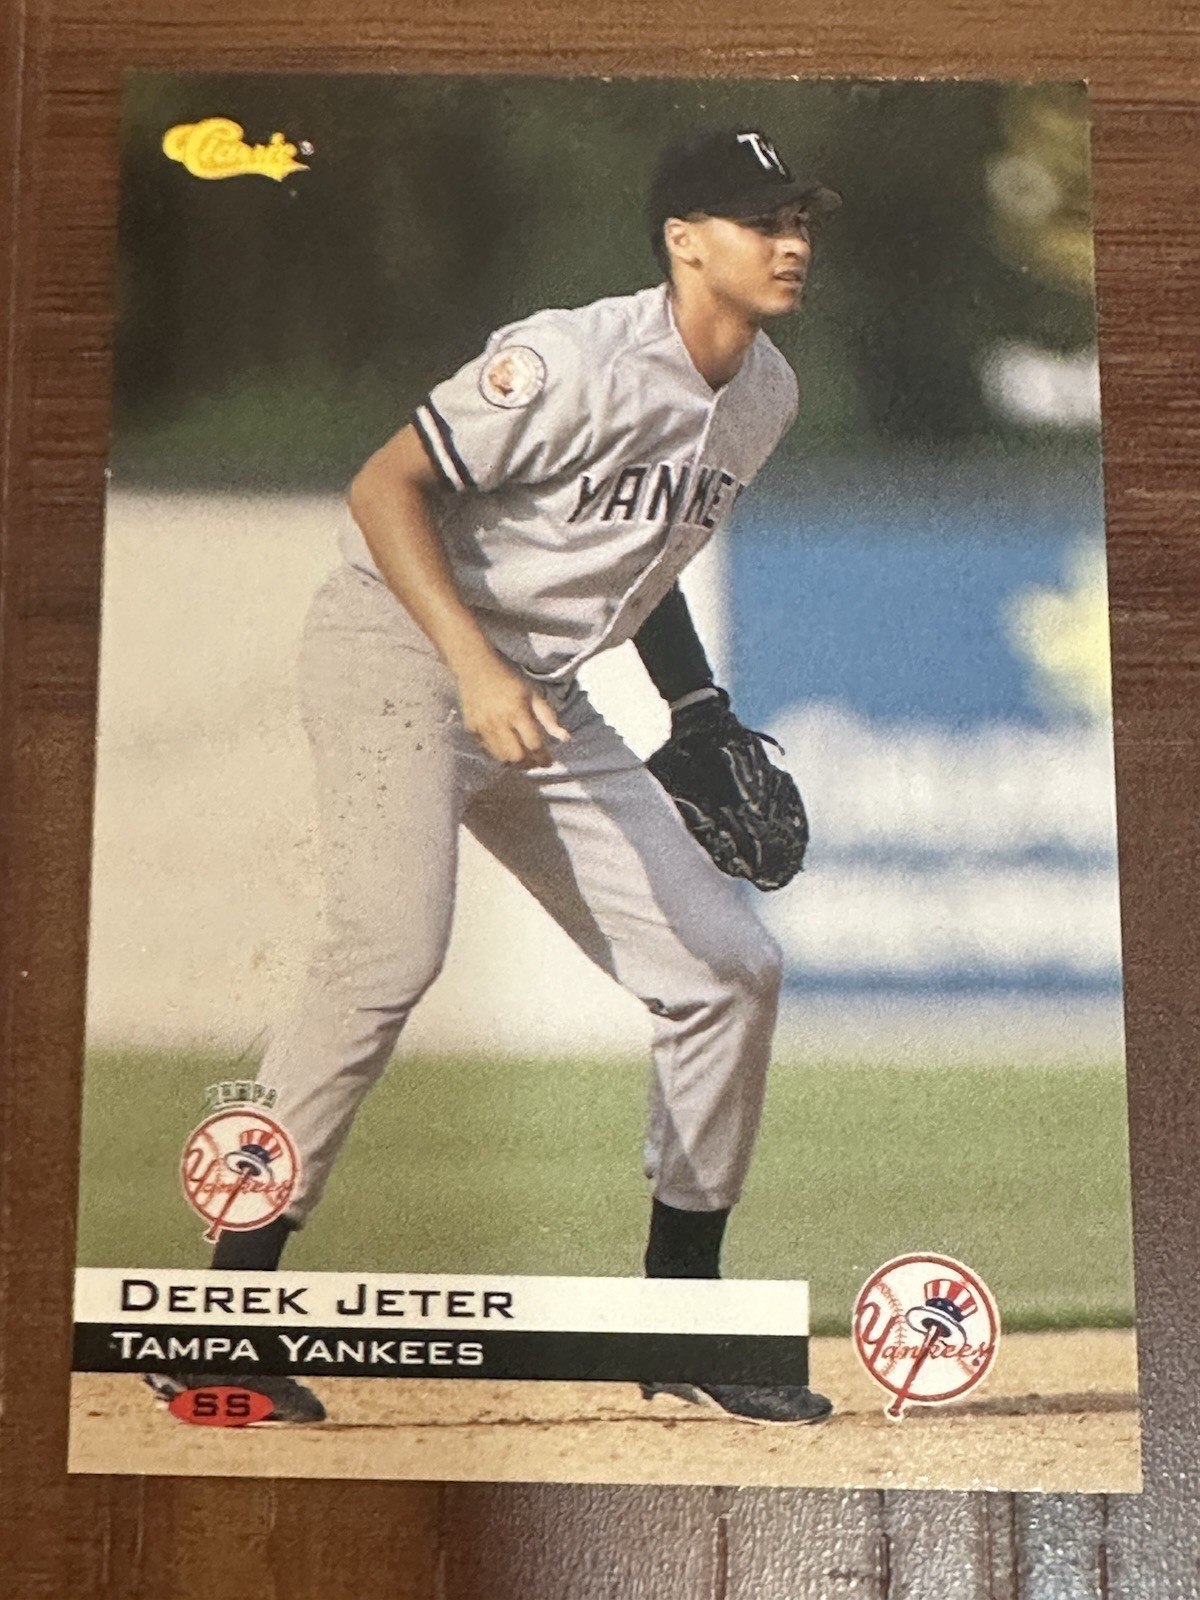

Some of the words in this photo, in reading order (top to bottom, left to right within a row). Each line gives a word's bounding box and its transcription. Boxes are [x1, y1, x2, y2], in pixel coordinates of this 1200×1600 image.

[566, 462, 745, 529] YANKE
[120, 1278, 309, 1316] DEREK
[335, 1283, 515, 1319] JETER
[111, 1330, 260, 1362] TAMPA
[278, 1333, 485, 1366] YANKEES
[191, 1392, 251, 1417] SS
